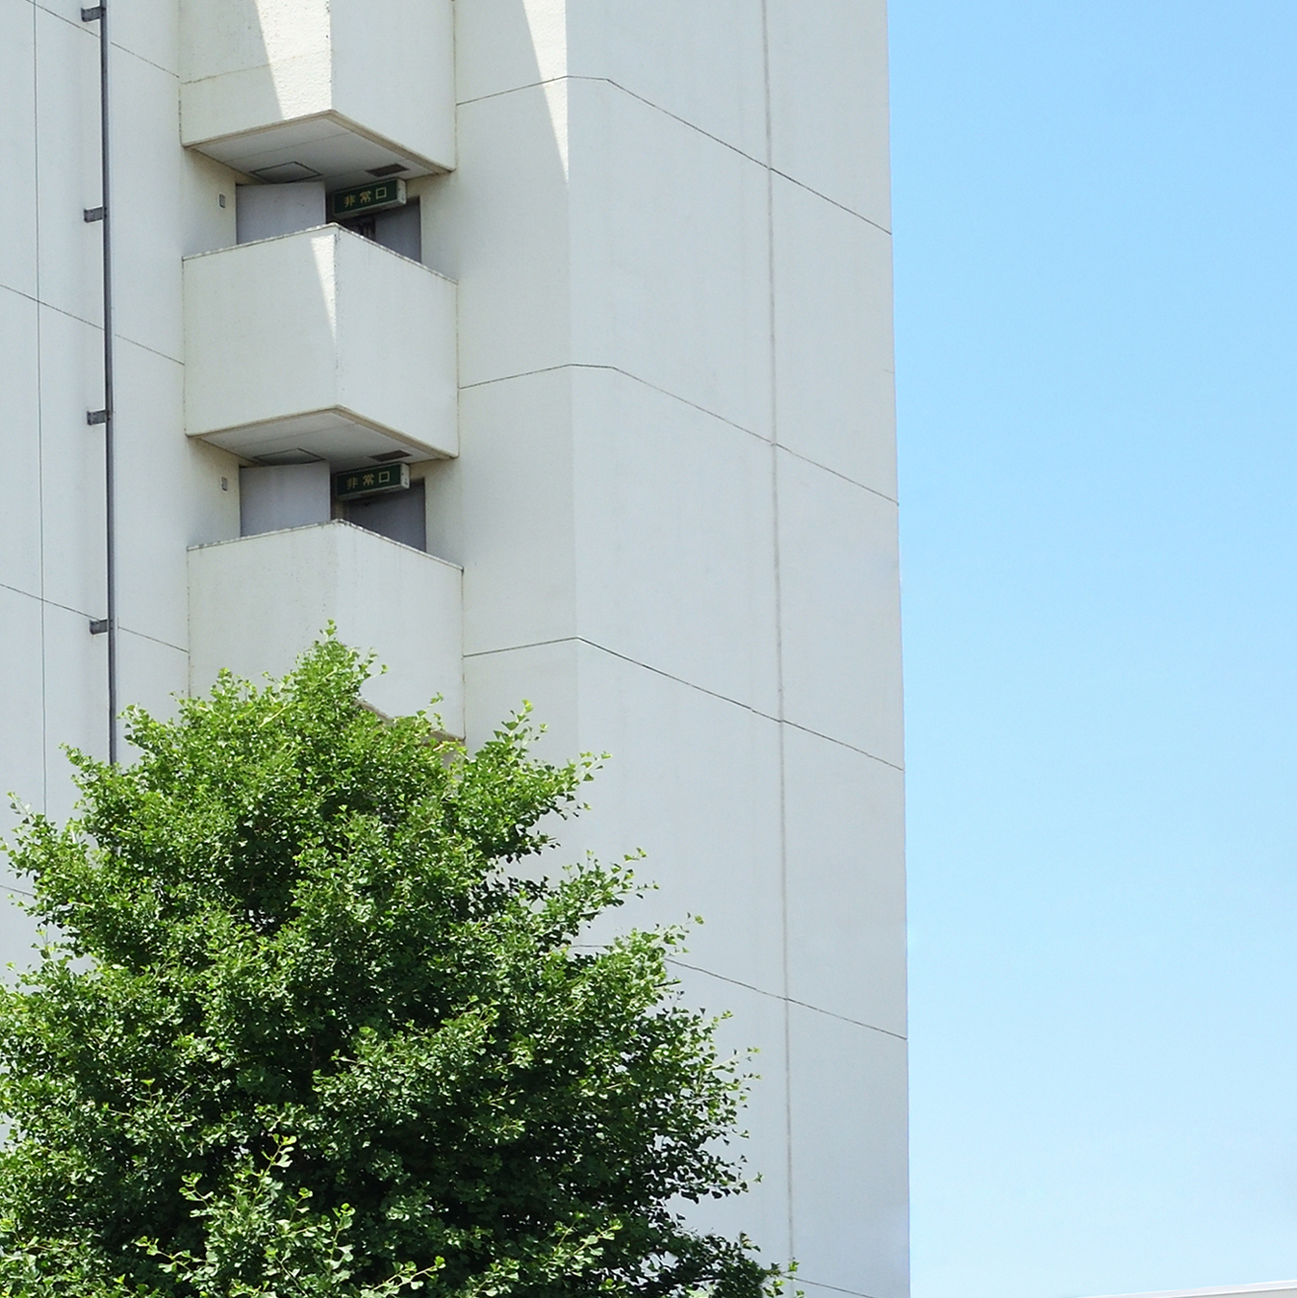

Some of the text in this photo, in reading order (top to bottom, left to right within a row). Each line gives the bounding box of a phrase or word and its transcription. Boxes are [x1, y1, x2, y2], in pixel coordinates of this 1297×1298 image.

[344, 187, 387, 208] 非常口
[347, 471, 390, 490] 非常口
